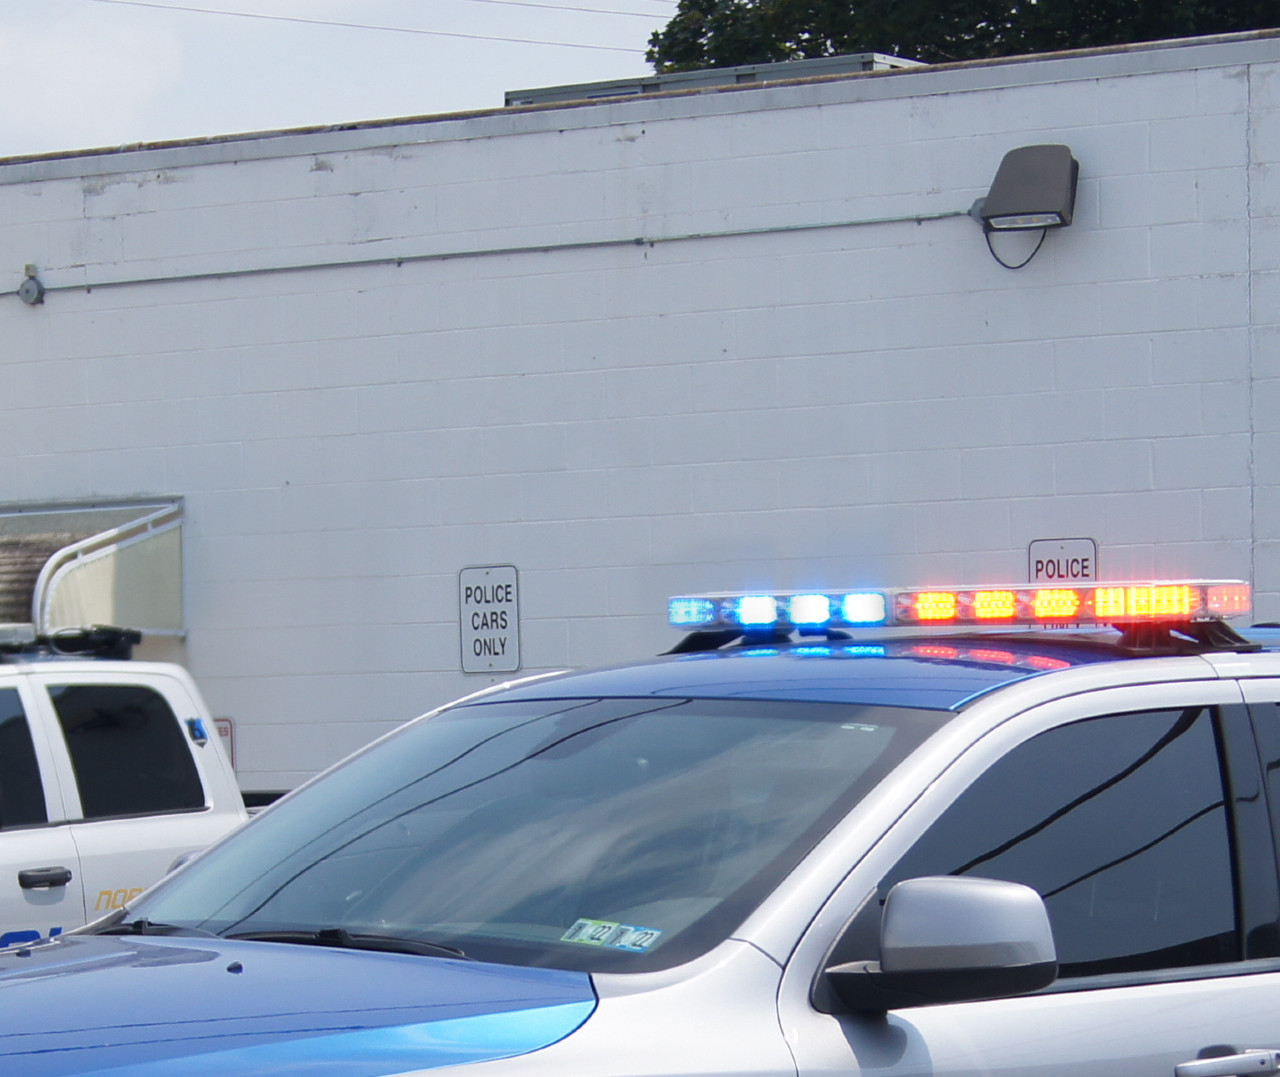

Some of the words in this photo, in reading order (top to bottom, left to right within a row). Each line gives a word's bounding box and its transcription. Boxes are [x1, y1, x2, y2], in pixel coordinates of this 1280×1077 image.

[1035, 558, 1090, 579] POLICE
[465, 584, 512, 604] POLICE
[471, 610, 508, 630] CARS
[473, 637, 507, 656] ONLY
